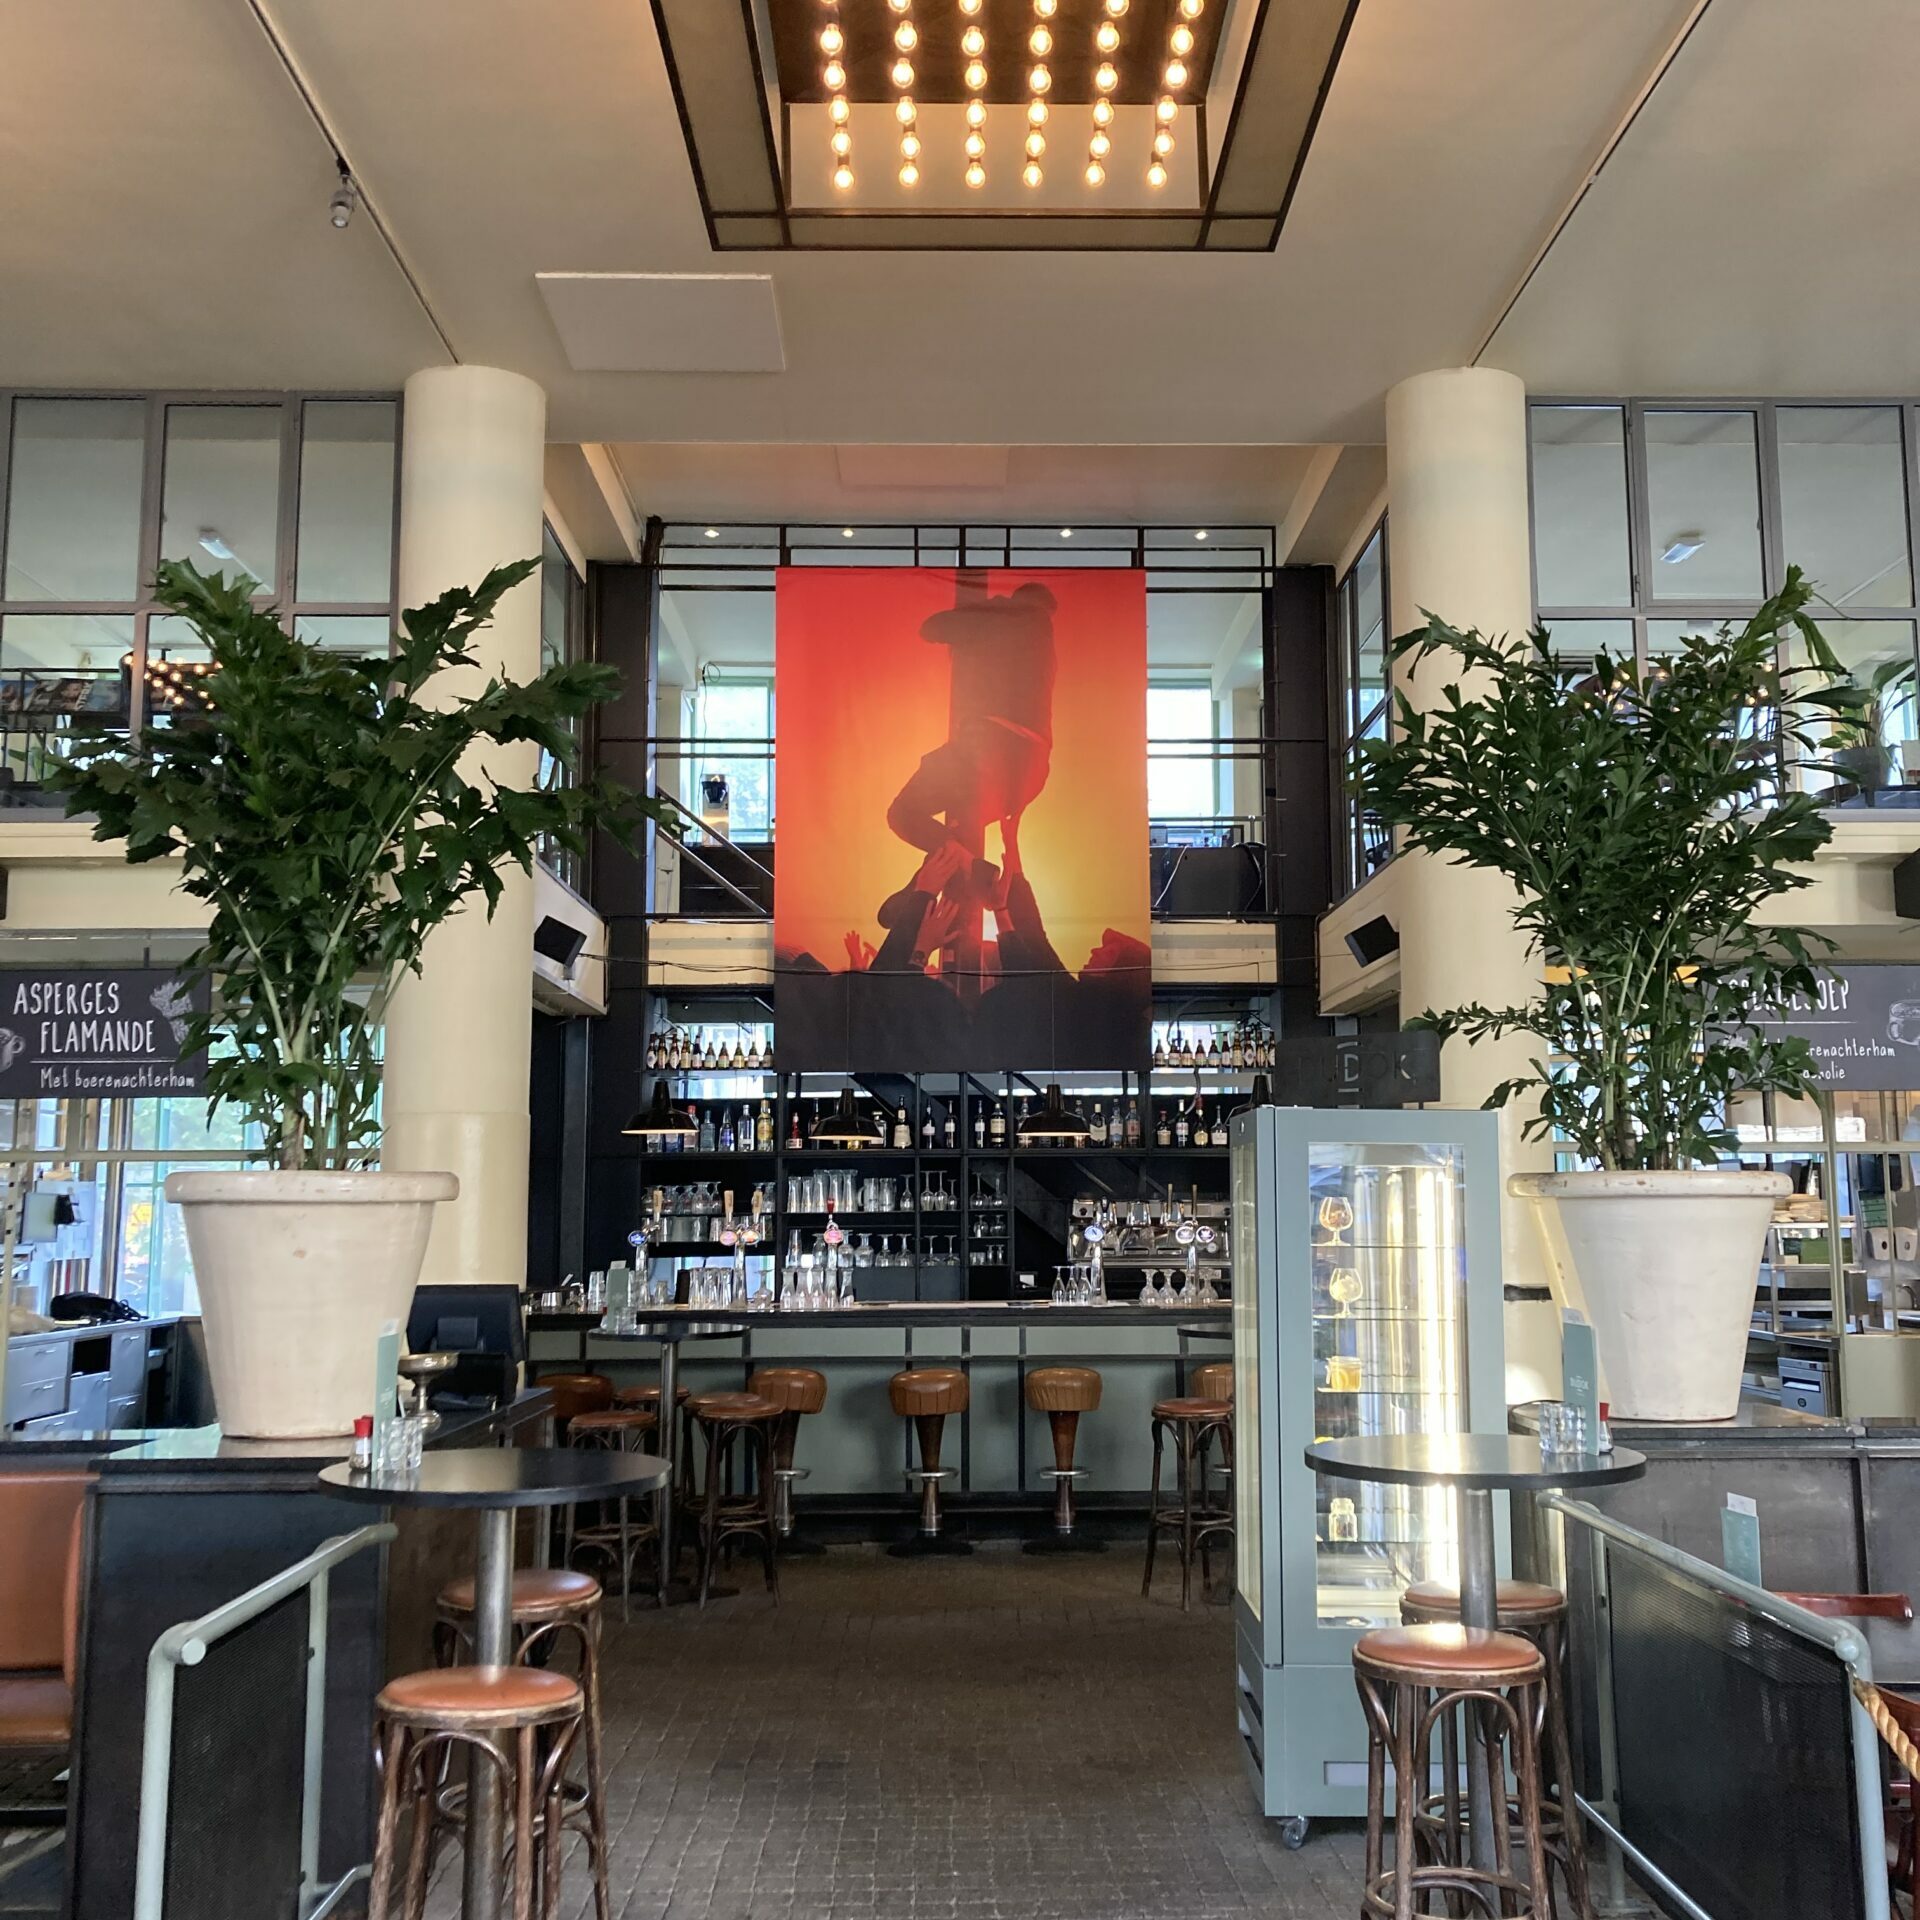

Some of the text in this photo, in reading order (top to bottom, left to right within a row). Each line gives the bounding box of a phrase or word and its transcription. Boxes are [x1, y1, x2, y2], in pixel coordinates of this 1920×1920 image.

[13, 982, 120, 1015] ASPERGES
[40, 1020, 156, 1054] FLAMANDE
[1806, 1038, 1896, 1057] renachterham
[40, 1067, 195, 1089] Met boerenachterham
